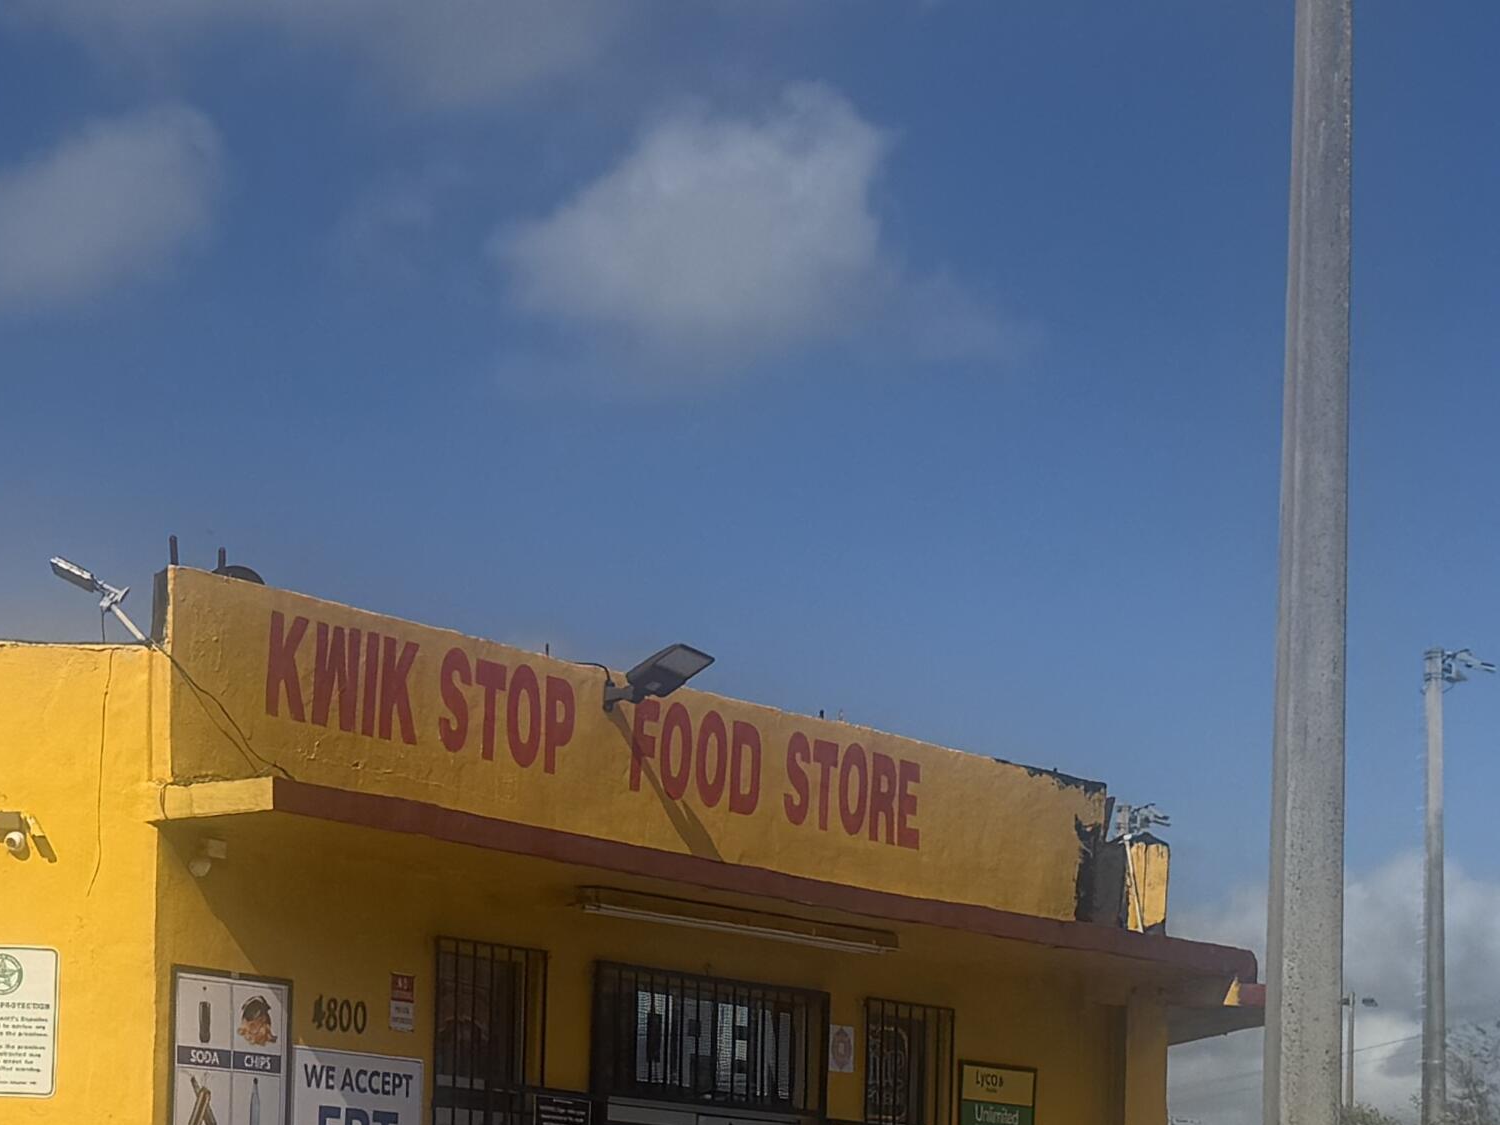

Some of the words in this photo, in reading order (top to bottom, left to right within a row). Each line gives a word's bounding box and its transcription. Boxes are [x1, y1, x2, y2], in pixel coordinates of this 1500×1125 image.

[265, 610, 421, 746] KWIK
[438, 647, 575, 774] STOP
[629, 700, 762, 816] FOOD
[783, 732, 921, 850] STORE
[0, 1002, 50, 1010] PROTECTION
[312, 995, 368, 1034] 4800
[189, 1049, 220, 1065] SODA
[636, 990, 791, 1099] OPEN
[244, 1056, 272, 1070] CHIPS
[304, 1063, 334, 1090] WE
[340, 1069, 413, 1098] ACCEPT
[975, 1103, 1019, 1125] Unlimited
